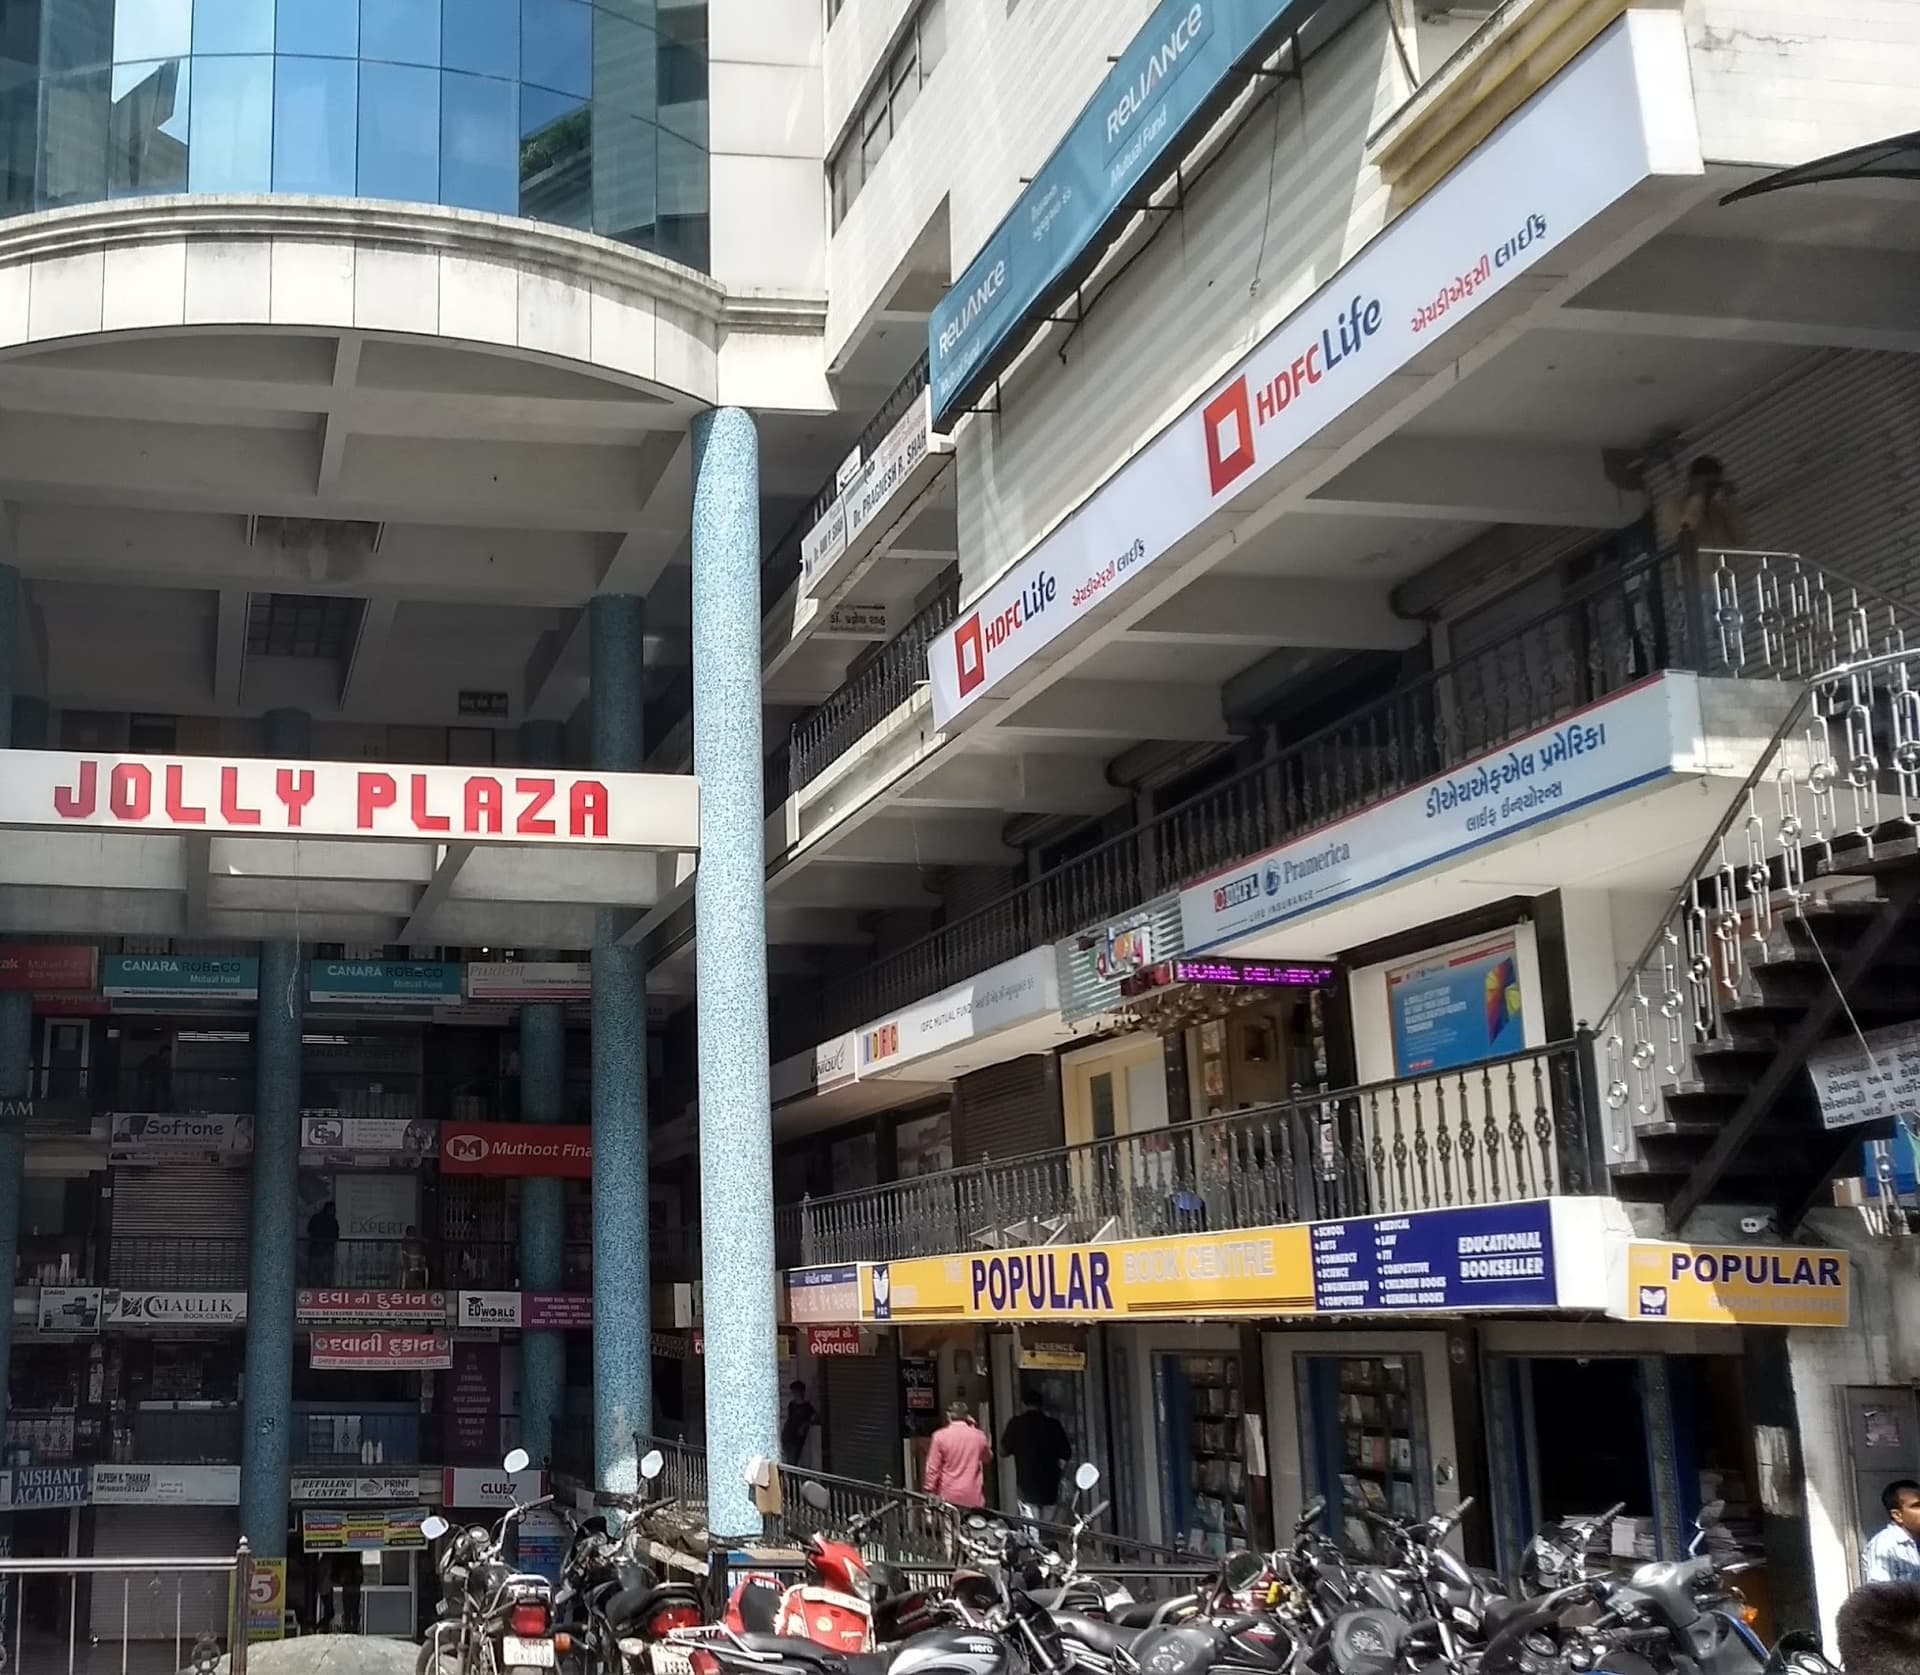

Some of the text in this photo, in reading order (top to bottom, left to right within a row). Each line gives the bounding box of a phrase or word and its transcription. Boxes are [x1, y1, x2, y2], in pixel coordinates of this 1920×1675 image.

[53, 760, 609, 837] JOLLY PLAZA
[1283, 842, 1351, 885] Pramerica
[0, 958, 18, 971] ak
[122, 960, 240, 973] CANARA ROBECO
[327, 965, 443, 979] CANARA ROBECO
[190, 974, 241, 984] Mutual Fund
[146, 1119, 224, 1136] Softone
[492, 1142, 559, 1156] Muthoot
[1458, 1231, 1542, 1254] EDUCATIONAL
[1460, 1257, 1545, 1278] BOOKSELLER
[1671, 1253, 1842, 1286] POPULAR
[971, 1251, 1113, 1310] POPULAR
[153, 1299, 233, 1312] MAULIK
[318, 1292, 349, 1304] દવા
[376, 1293, 427, 1309] દુકાન
[329, 1333, 435, 1356] દવાની દુકાન
[19, 1468, 83, 1486] NISHANT
[302, 1480, 353, 1489] REFILLING
[384, 1480, 410, 1488] PRINT
[15, 1485, 84, 1504] ACADEMY
[307, 1488, 348, 1498] CENTER
[390, 1488, 414, 1497] Vision
[249, 1574, 273, 1603] 5
